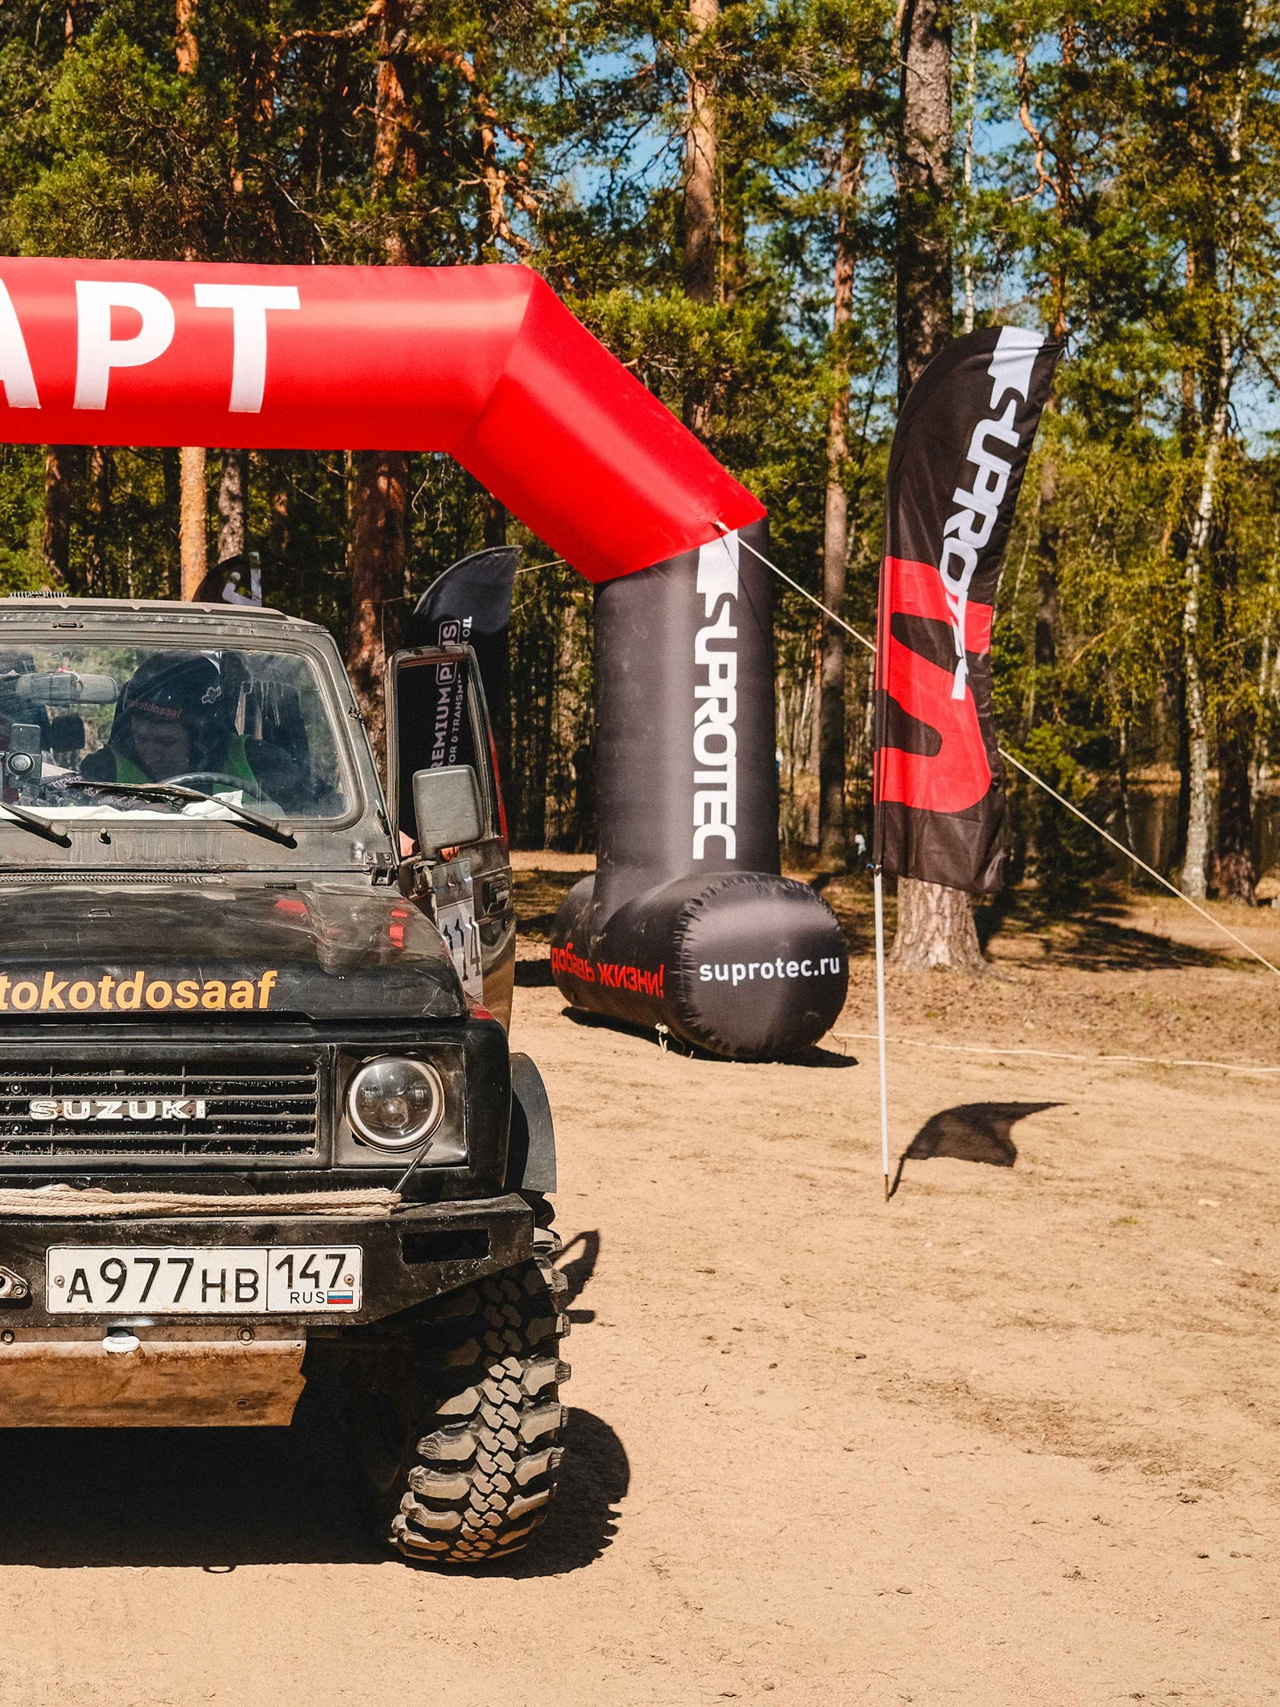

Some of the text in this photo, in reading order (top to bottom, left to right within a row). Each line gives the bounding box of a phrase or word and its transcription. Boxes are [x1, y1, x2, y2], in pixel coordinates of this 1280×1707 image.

[431, 624, 457, 769] REMIUM PS
[692, 530, 739, 860] SUPROTEC
[699, 957, 840, 986] suprotec.ru
[28, 1099, 207, 1121] SUZUKI
[274, 1253, 346, 1289] 147
[289, 1291, 325, 1304] RUS
